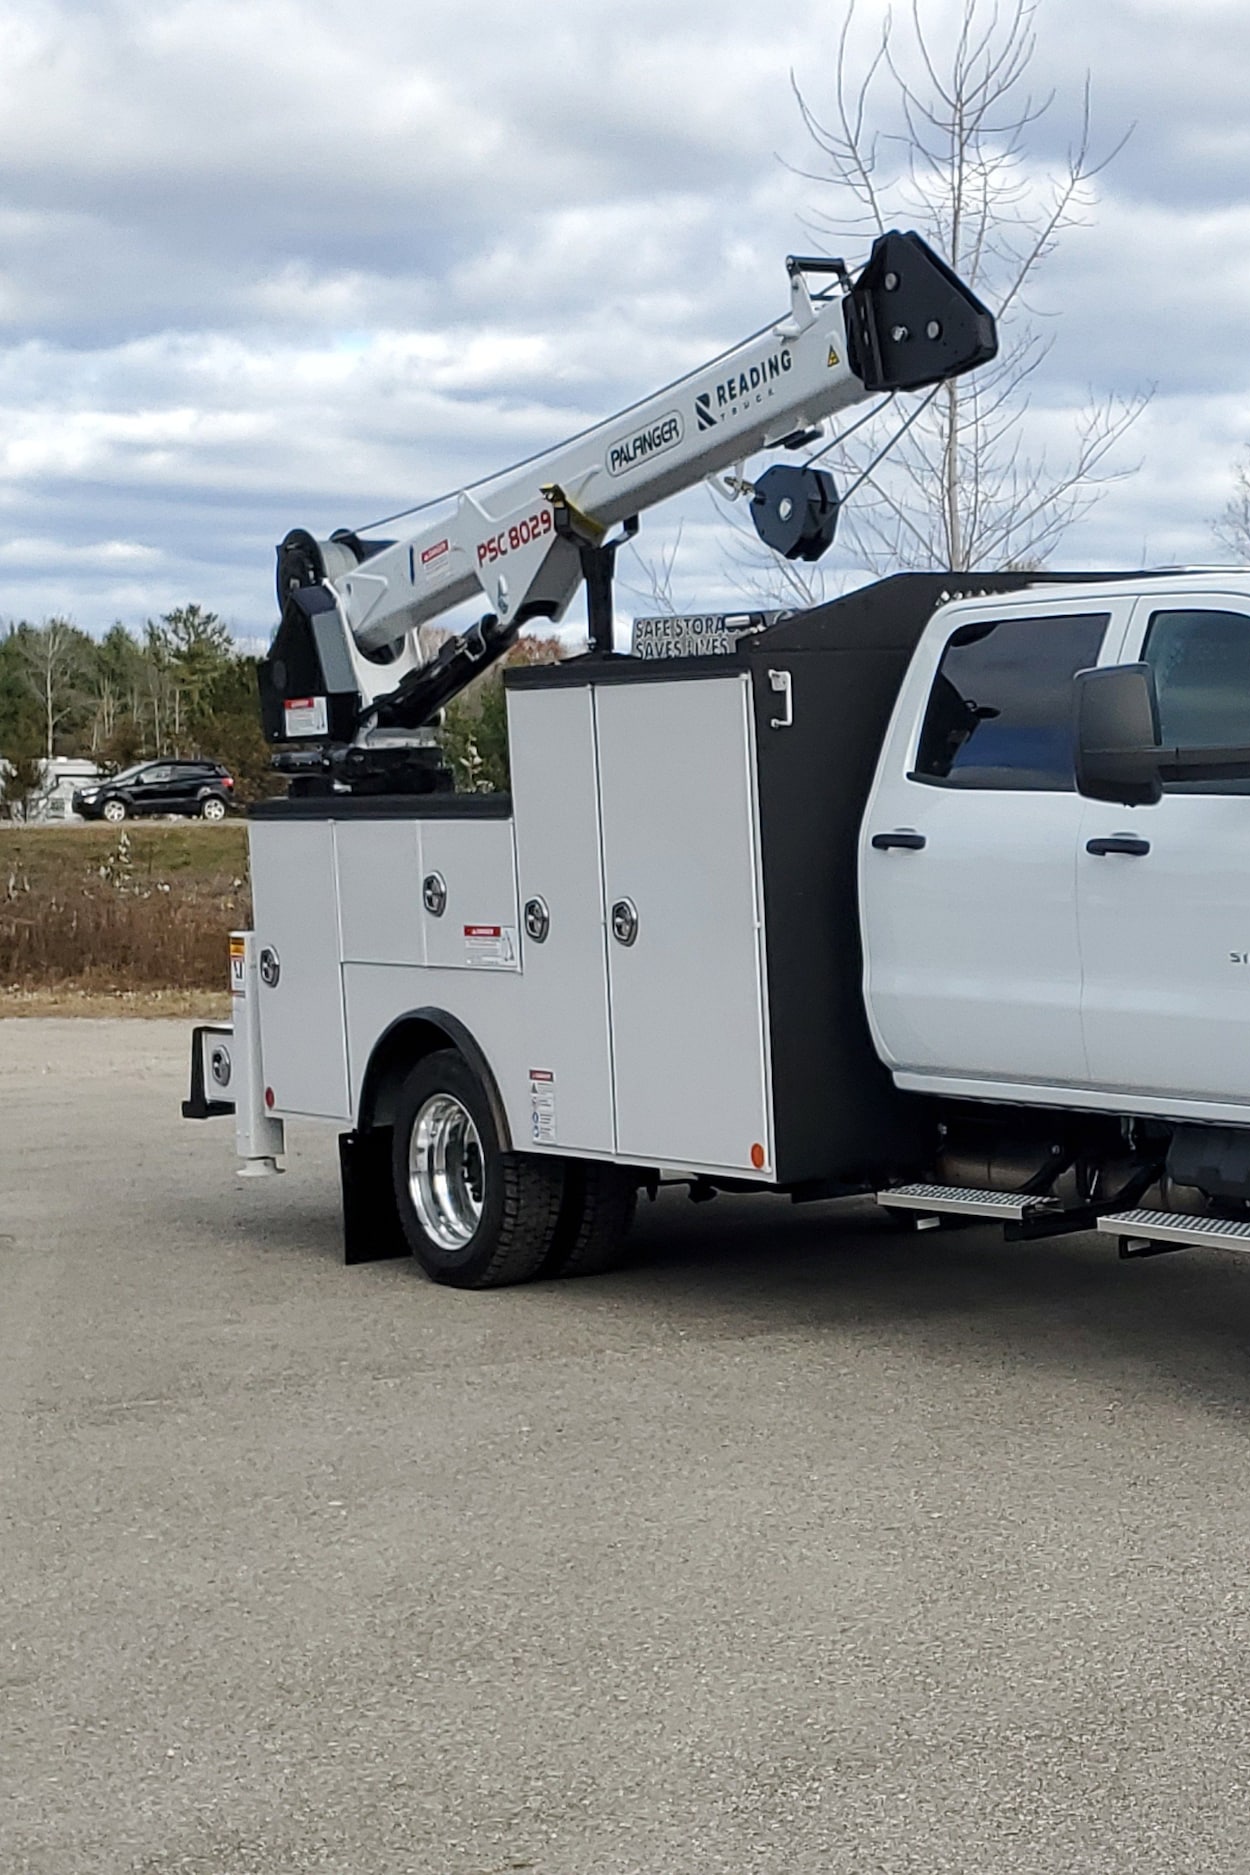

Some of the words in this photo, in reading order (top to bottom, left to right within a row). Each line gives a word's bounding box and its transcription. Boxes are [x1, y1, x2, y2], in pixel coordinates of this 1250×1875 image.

[716, 349, 792, 408] READING
[720, 389, 776, 422] TRUCK
[610, 417, 680, 472] PALFINGER
[476, 531, 508, 568] PSC
[508, 509, 551, 550] 8029
[636, 620, 670, 638] SAFE
[675, 615, 729, 636] STORA
[636, 640, 682, 659] SAVES
